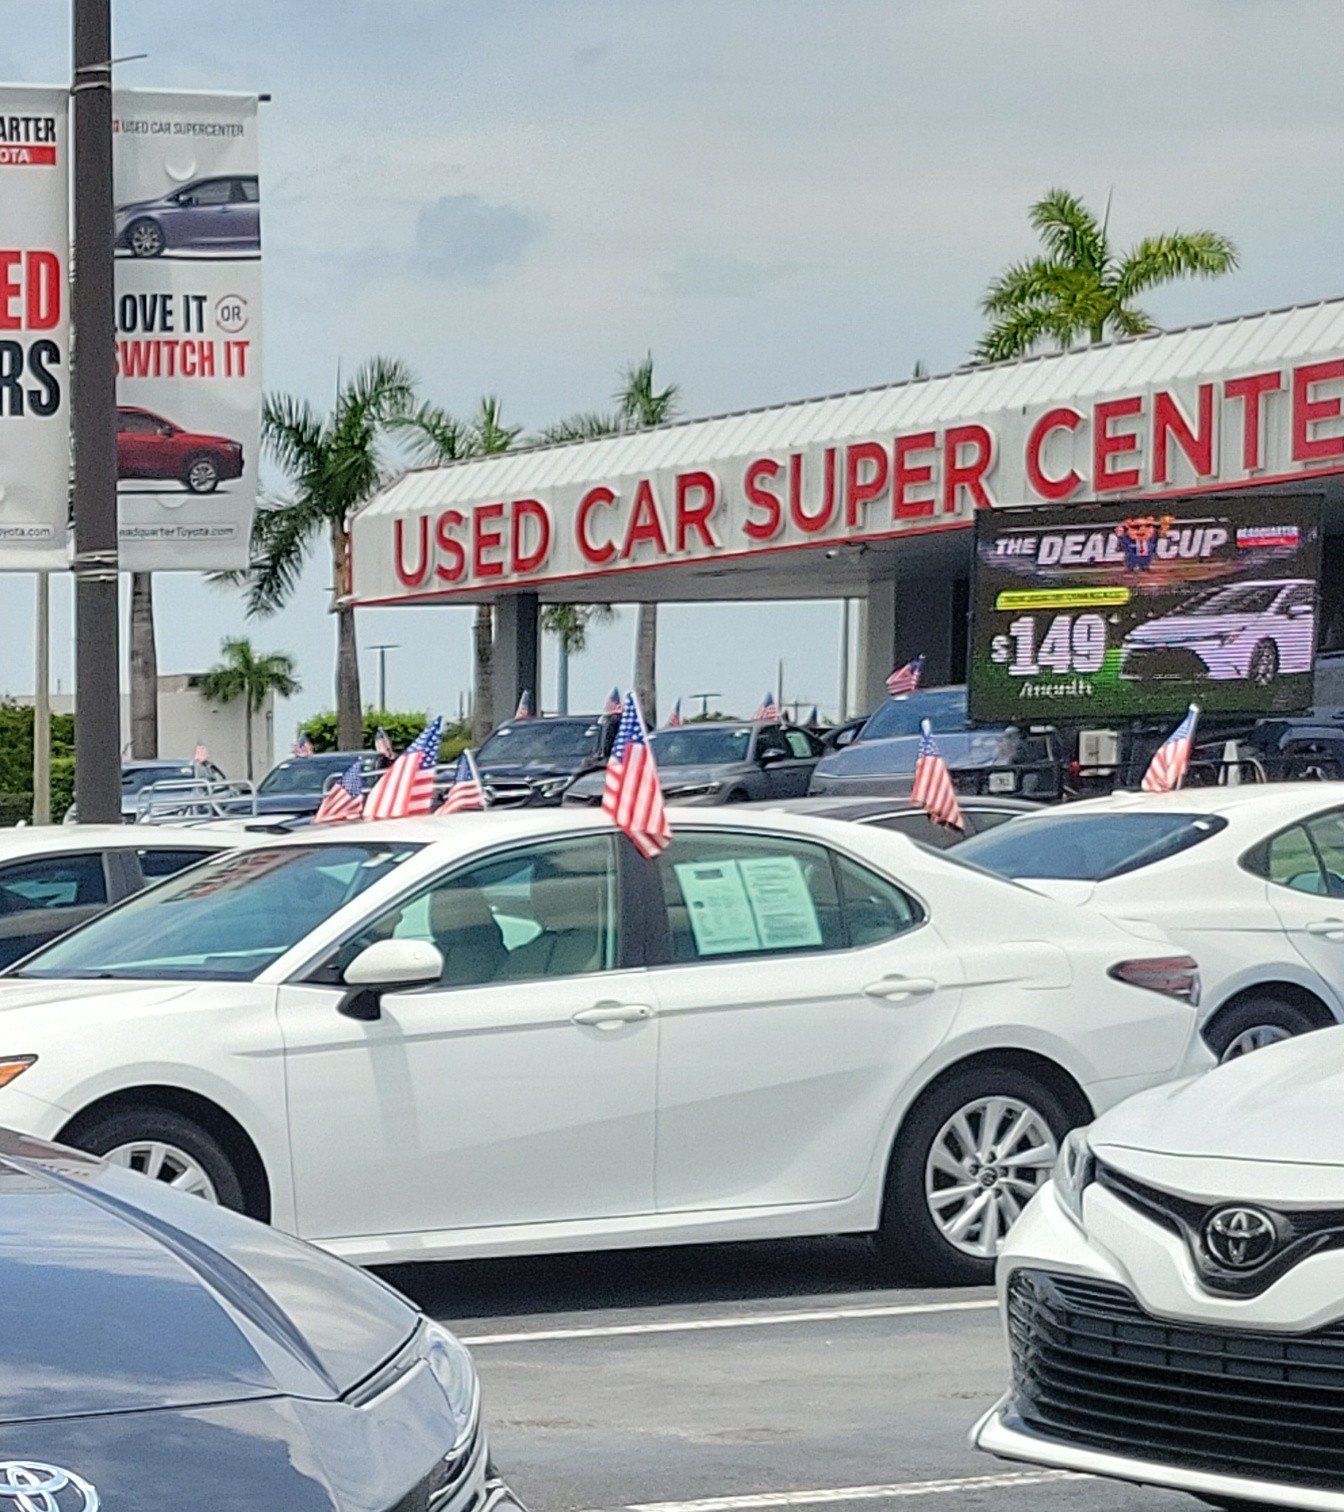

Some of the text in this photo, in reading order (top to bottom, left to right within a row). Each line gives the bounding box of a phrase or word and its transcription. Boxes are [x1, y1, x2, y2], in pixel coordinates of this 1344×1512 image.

[121, 120, 244, 137] USED CAR SUPERCENTER
[115, 294, 242, 333] OVE IT OR
[115, 340, 250, 377] WITCH IT
[394, 499, 551, 589] USED
[575, 471, 717, 565] CAR
[743, 424, 992, 541] SUPER
[119, 526, 234, 538] eadquarterToyota.com
[995, 528, 1227, 565] THE DEAL CUP
[991, 613, 1106, 676] $149
